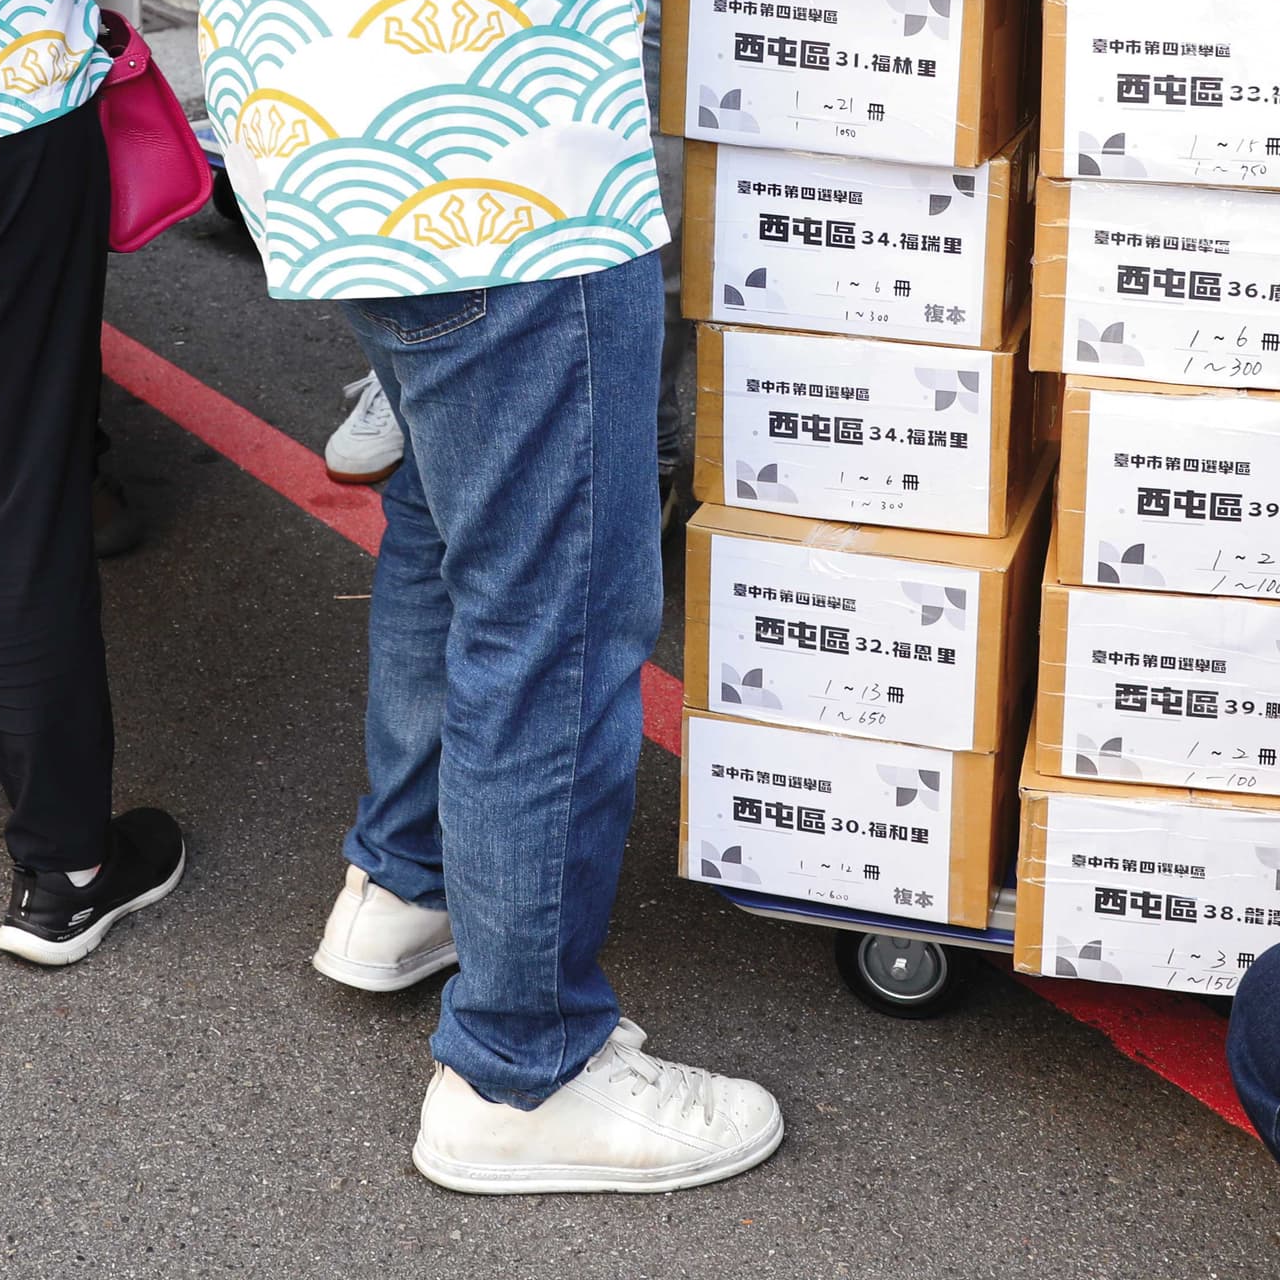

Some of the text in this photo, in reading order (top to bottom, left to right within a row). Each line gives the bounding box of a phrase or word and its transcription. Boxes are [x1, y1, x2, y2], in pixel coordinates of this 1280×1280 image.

[1093, 38, 1231, 58] 臺中市第四選舉區
[737, 180, 863, 205] 臺中市第四選舉區
[1094, 230, 1230, 255] 臺中市第四選舉區
[924, 303, 966, 325] 複本
[746, 378, 870, 402] 臺中市第四選舉區
[1114, 453, 1251, 476] 臺中市第四選舉區
[733, 582, 857, 612] 臺中市第四選舉區
[1092, 649, 1227, 674] 臺中市第四選舉區
[711, 764, 832, 794] 臺中市第四選舉區
[894, 887, 934, 909] 複本
